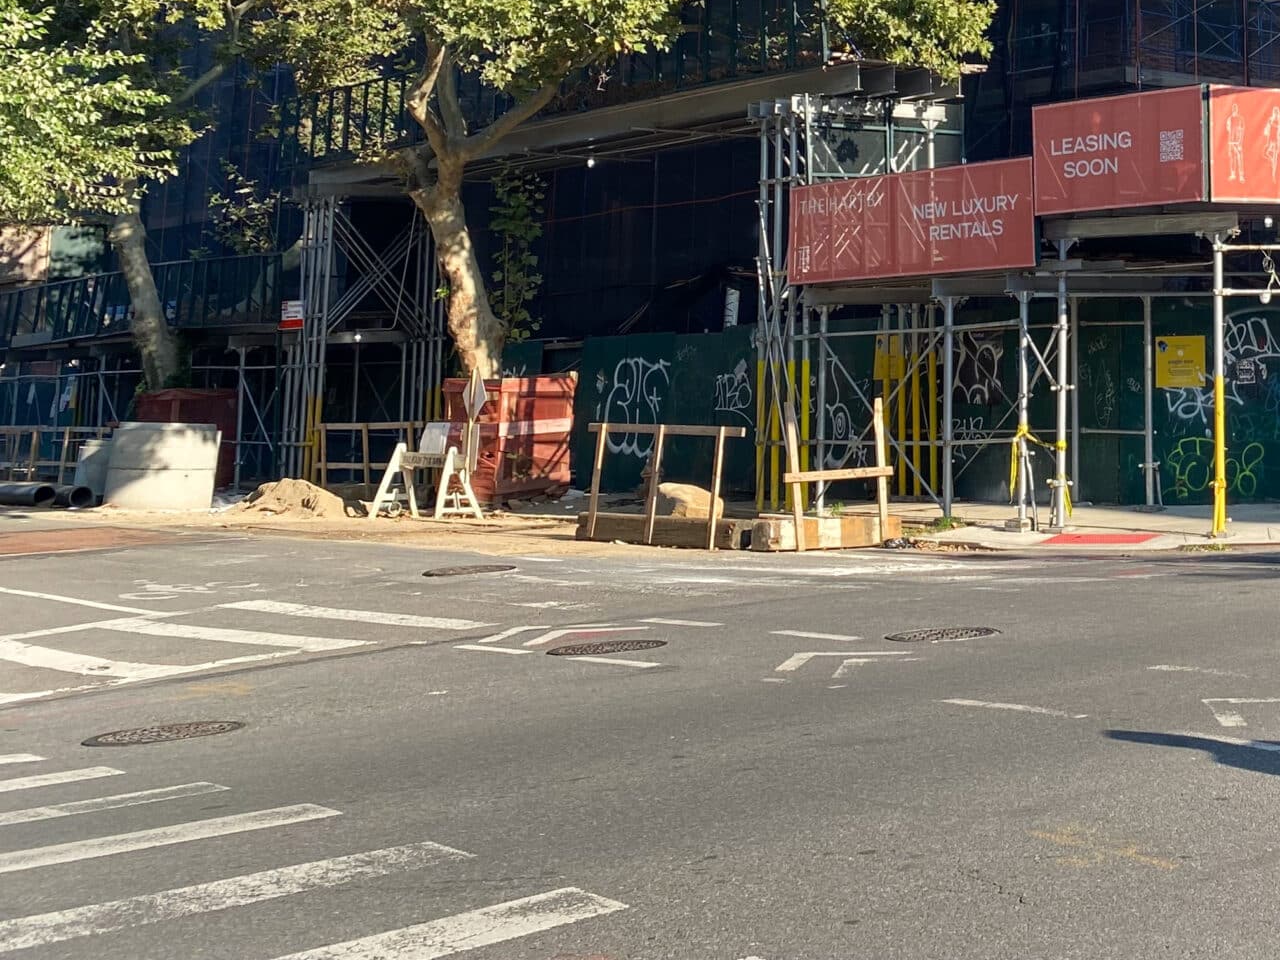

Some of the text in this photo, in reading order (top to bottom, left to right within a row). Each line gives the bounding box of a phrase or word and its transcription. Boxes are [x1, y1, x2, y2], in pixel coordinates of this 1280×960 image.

[1050, 131, 1132, 156] LEASING
[1063, 157, 1119, 179] SOON
[800, 198, 825, 216] THE
[913, 193, 1019, 220] NEW LUXURY
[929, 219, 1004, 241] RENTALS
